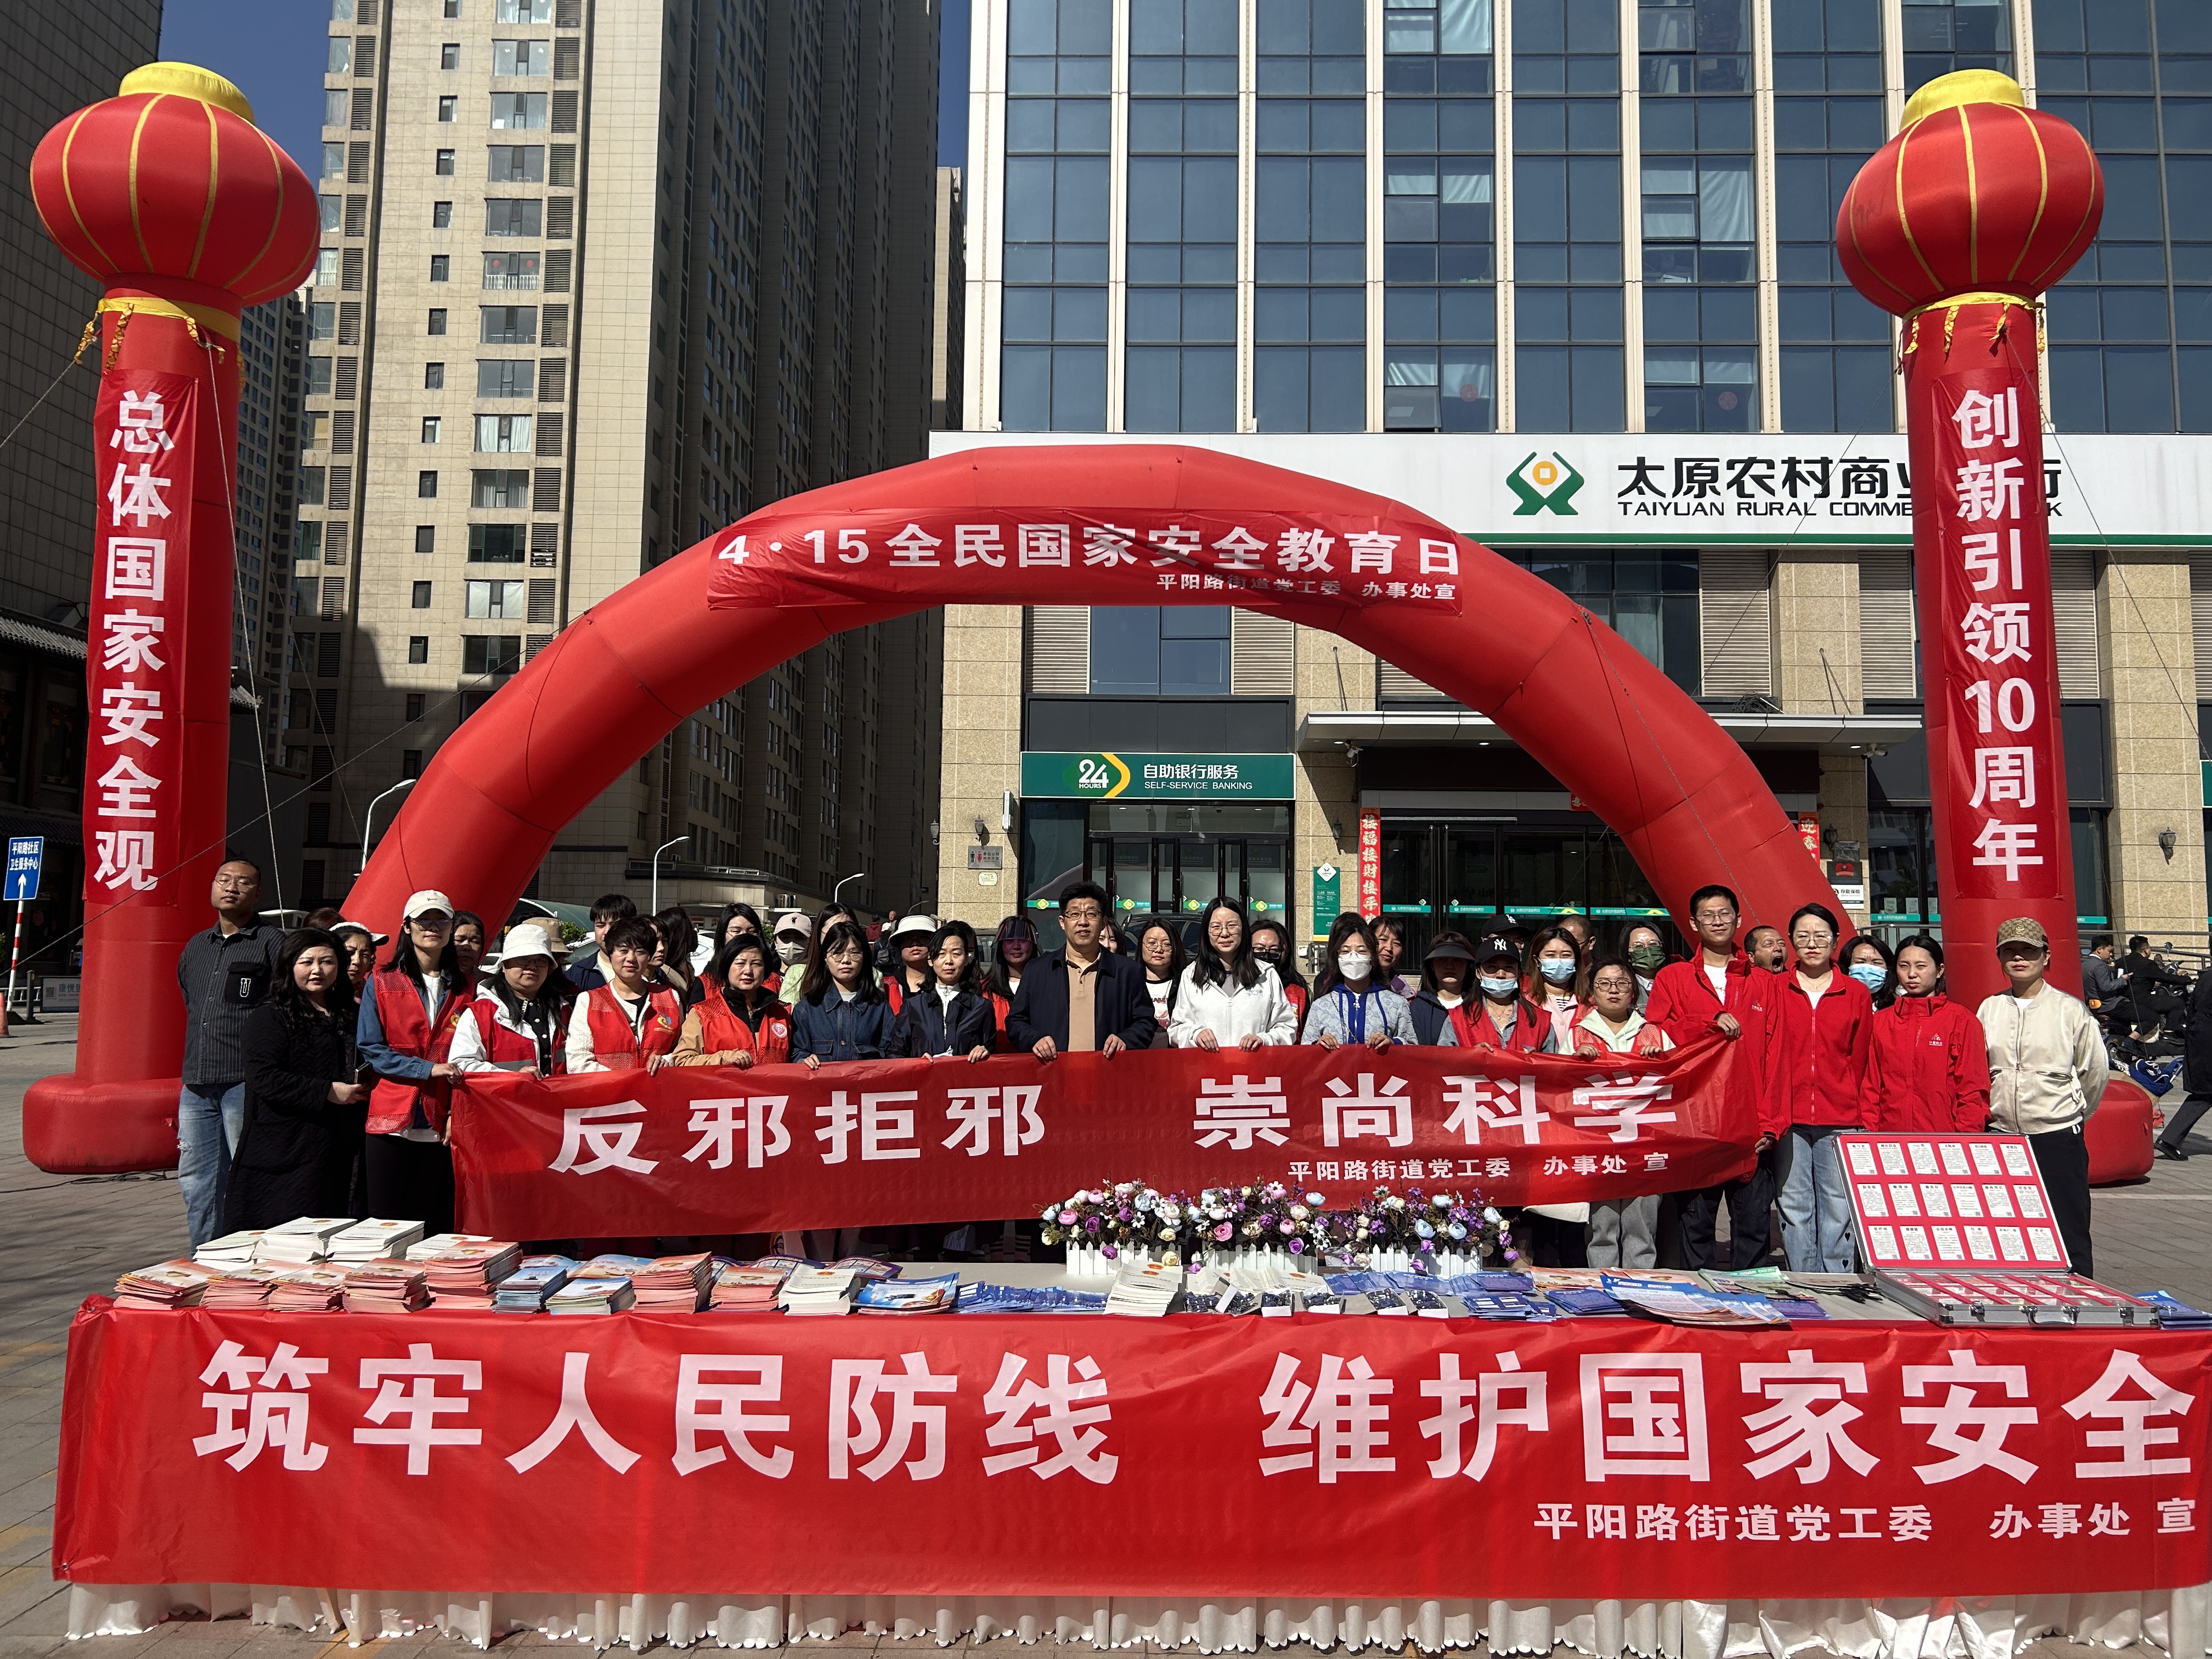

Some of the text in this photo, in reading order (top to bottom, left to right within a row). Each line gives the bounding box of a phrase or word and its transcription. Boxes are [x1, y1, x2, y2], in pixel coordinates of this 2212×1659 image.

[1618, 456, 1911, 498] 太原农村商
[1618, 502, 1913, 516] TAIYUAN RURAL COMME
[1157, 572, 1342, 597] 平阳路街道党工委
[94, 390, 174, 890] 总体国家安全观
[1951, 387, 2044, 882] 创新引领10周年
[1079, 759, 1109, 788] 24
[1144, 764, 1240, 780] 自助银行服务
[12, 841, 39, 855] 平阳路社区
[1801, 818, 1818, 859] 迎春
[9, 857, 38, 870] 卫生服务中心
[1494, 939, 1507, 951] NY
[549, 1073, 1678, 1176] 反邪拒邪 崇尚科学
[1288, 1157, 1511, 1182] 平阳路街道党工委
[1543, 1154, 1627, 1176] 办事处
[193, 1339, 2196, 1485] 筑牢人民防线 维护国家安全
[1534, 1497, 2195, 1542] 平阳路街道党工委 办事处 宣
